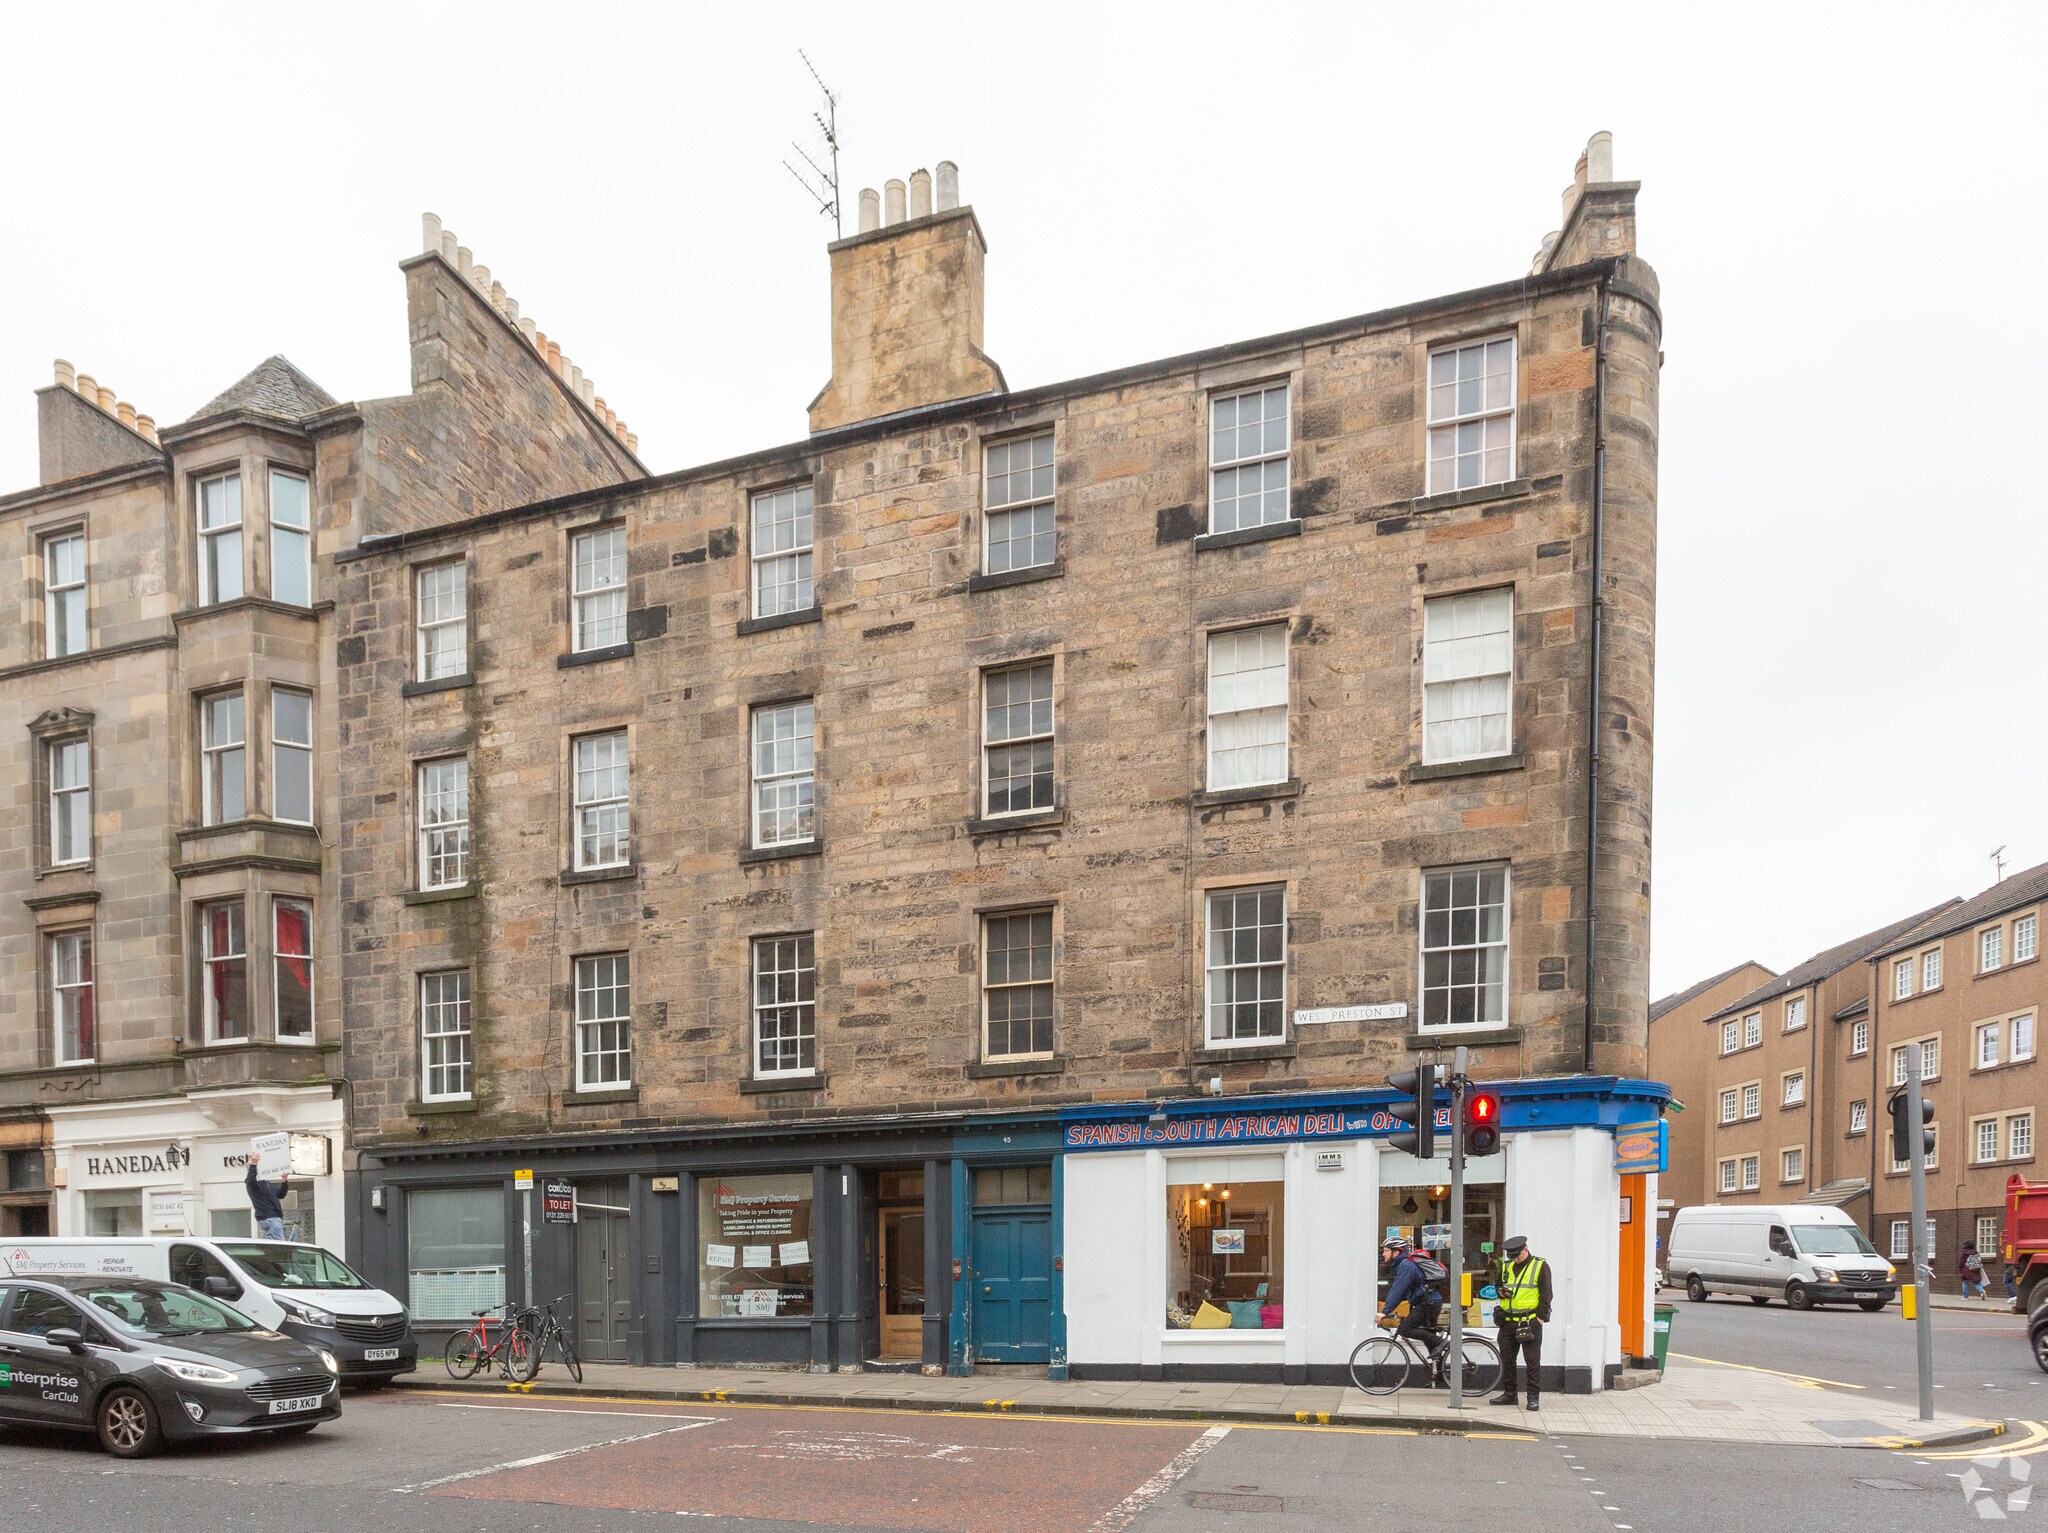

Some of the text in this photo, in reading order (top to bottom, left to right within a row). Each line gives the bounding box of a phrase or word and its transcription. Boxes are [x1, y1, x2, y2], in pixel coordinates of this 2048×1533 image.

[1299, 1006, 1404, 1022] WES PRESTON ST
[1067, 1124, 1141, 1145] SPANISH
[1153, 1119, 1216, 1141] SOUTH
[1217, 1115, 1299, 1139] AFRICAN
[1304, 1114, 1344, 1134] DELI
[255, 1137, 288, 1150] HANEDAN
[549, 1199, 571, 1210] TO LET
[736, 1195, 768, 1206] Property
[768, 1193, 800, 1203] Services
[770, 1208, 794, 1216] Property
[15, 1259, 86, 1271] SMJ Property Services
[709, 1256, 733, 1264] REPAIR
[367, 1348, 397, 1359] DY65 NPK
[0, 1370, 79, 1388] enterprise
[42, 1390, 79, 1403] CarClub
[276, 1398, 317, 1412] SL18 XKD
